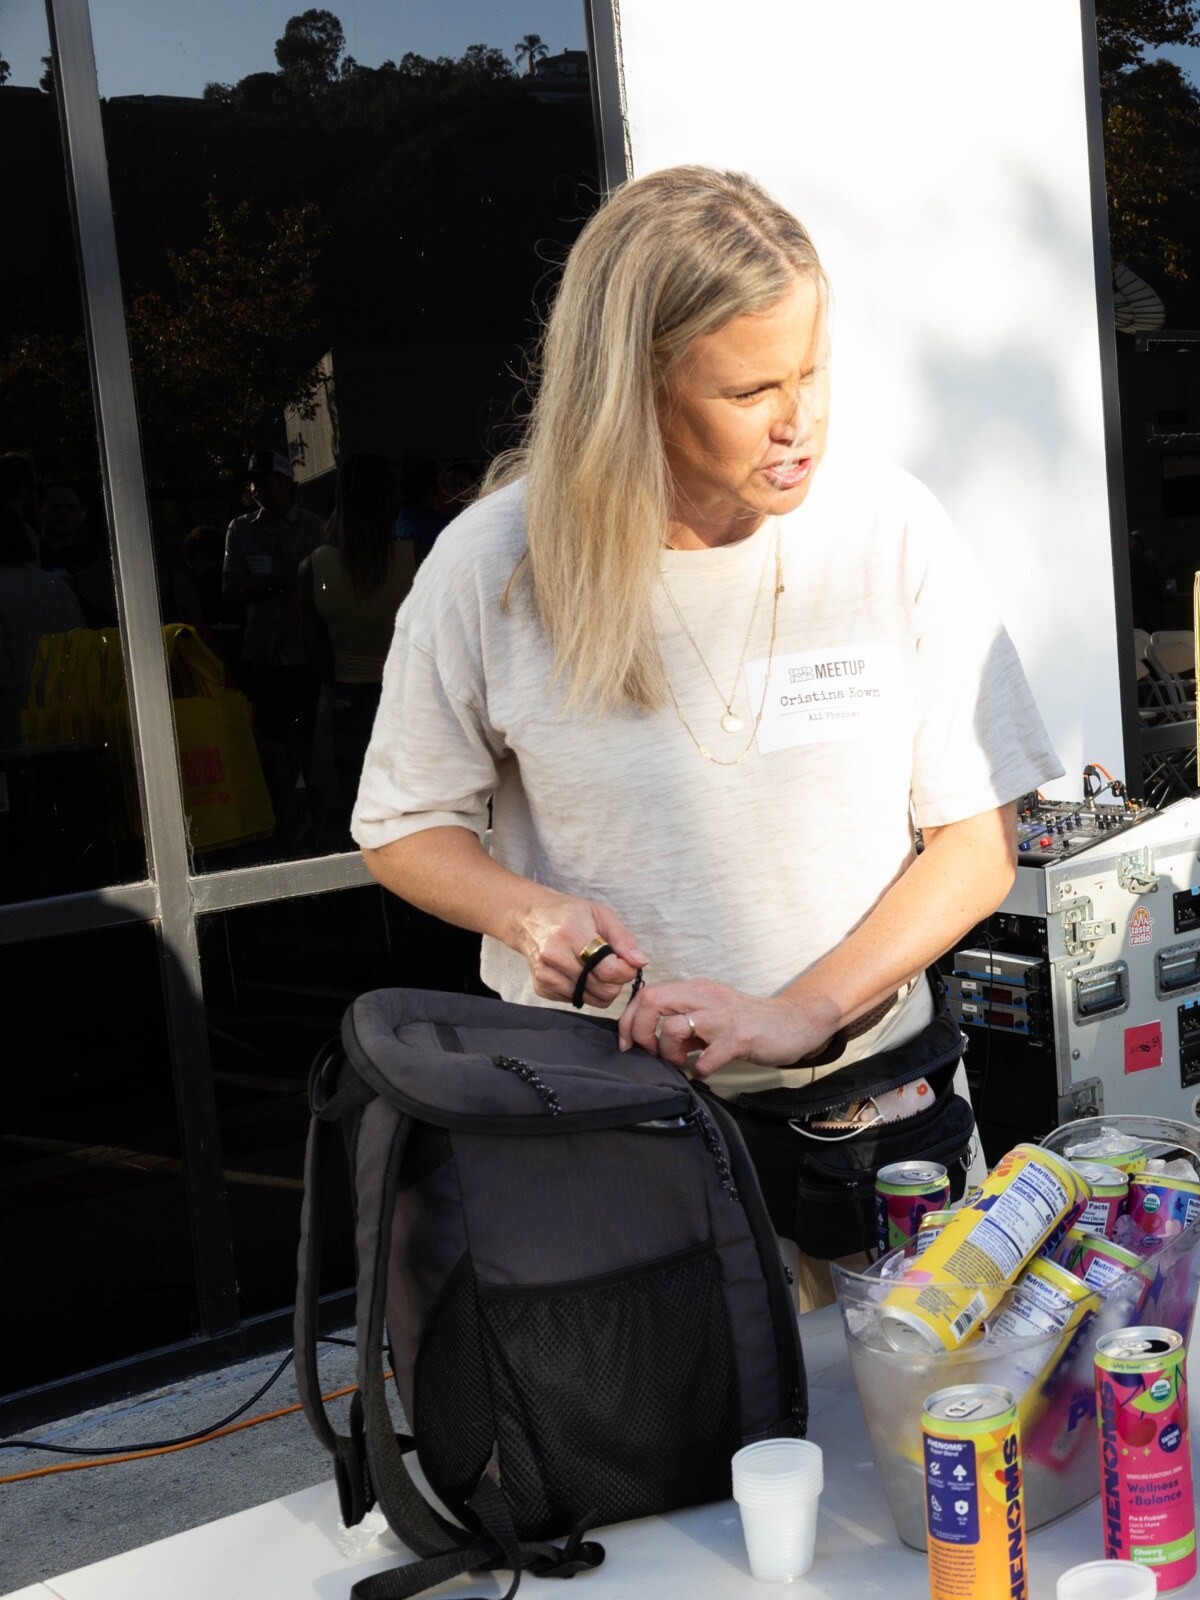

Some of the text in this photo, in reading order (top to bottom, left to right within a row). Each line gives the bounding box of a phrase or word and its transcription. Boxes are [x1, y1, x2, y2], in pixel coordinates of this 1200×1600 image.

[814, 659, 865, 679] MEETUP
[780, 690, 845, 707] Cristina
[1131, 925, 1151, 935] taste
[1130, 935, 1151, 945] radio
[1028, 1162, 1068, 1206] Nutrition Facts
[1011, 1182, 1036, 1203] Calories
[1045, 1213, 1053, 1226] 40
[1088, 1202, 1108, 1211] Facts
[1094, 1226, 1104, 1234] 45
[1026, 1273, 1053, 1295] Nutrition
[927, 1438, 963, 1452] PHENOMS
[930, 1447, 960, 1458] Super Blend
[1127, 1479, 1179, 1493] Wellness
[1129, 1490, 1182, 1506] +Balance
[1003, 1433, 1026, 1600] HENOMS
[1144, 1513, 1168, 1521] Probiotic
[1134, 1548, 1163, 1557] Cherry
[1134, 1555, 1168, 1564] Limeade
